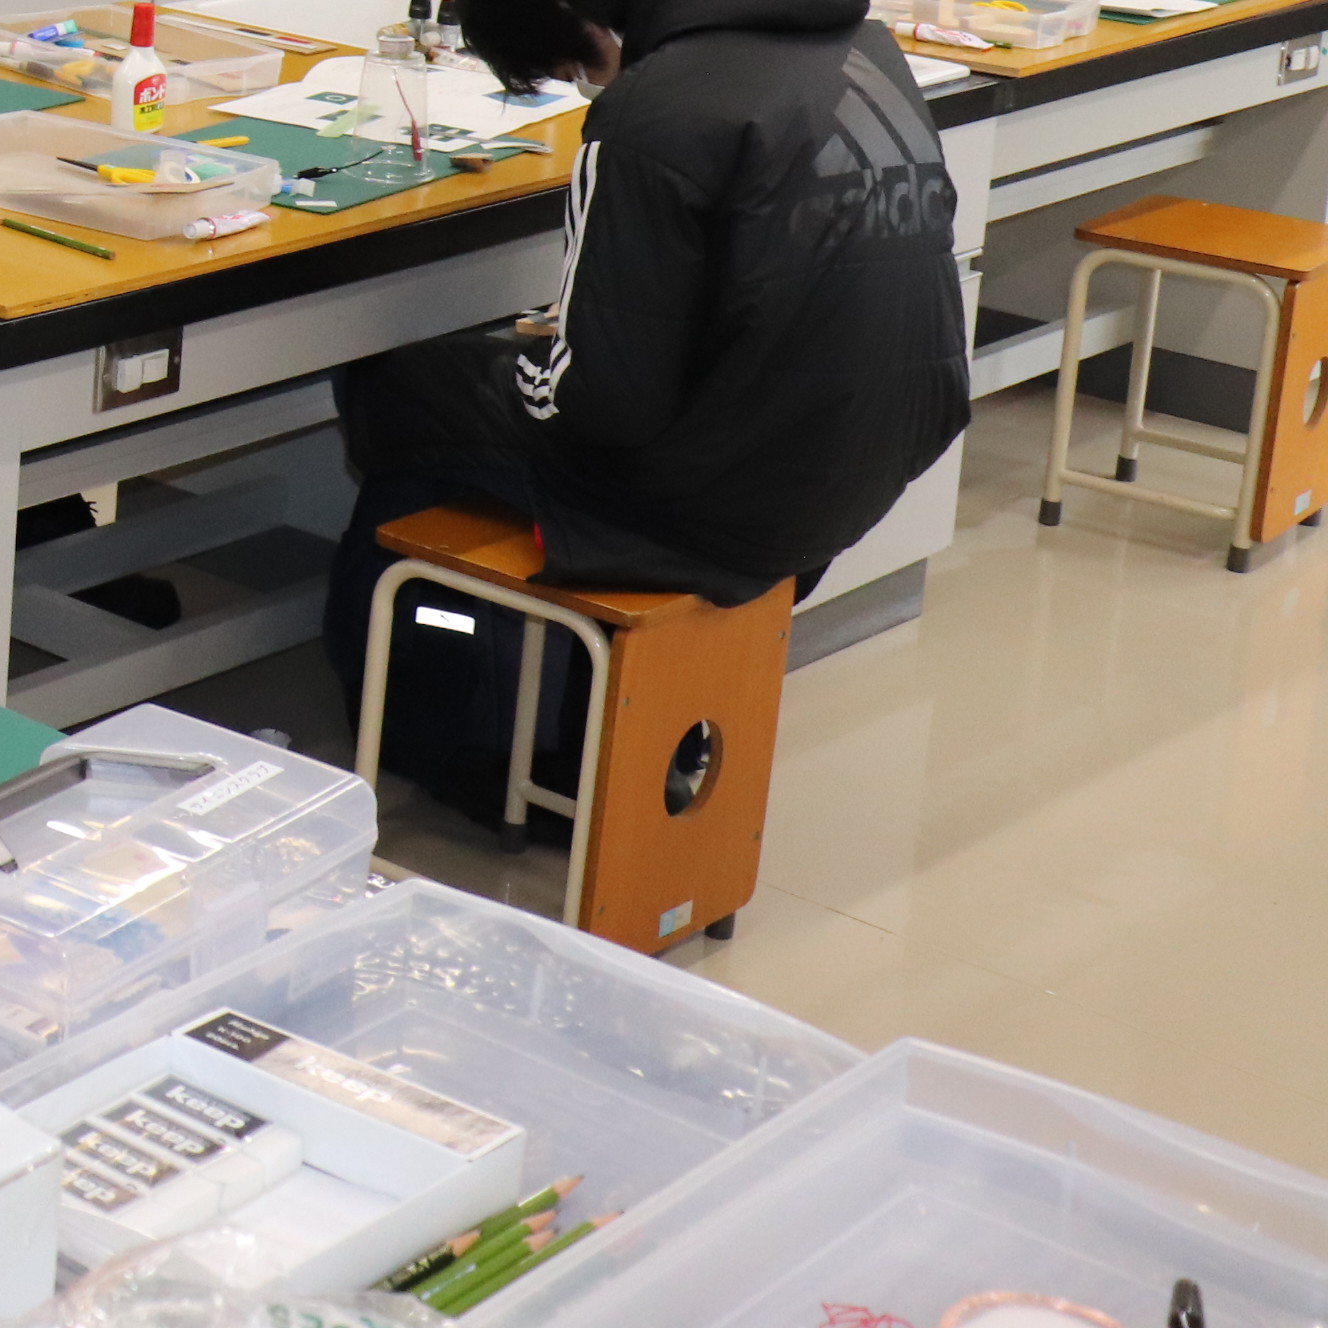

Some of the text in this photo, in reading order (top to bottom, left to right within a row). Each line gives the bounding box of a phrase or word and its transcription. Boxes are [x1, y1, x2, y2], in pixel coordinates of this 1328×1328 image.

[293, 1056, 393, 1103] keep
[165, 1085, 245, 1132] keep
[78, 1131, 156, 1180] keep
[125, 1109, 205, 1158] keep
